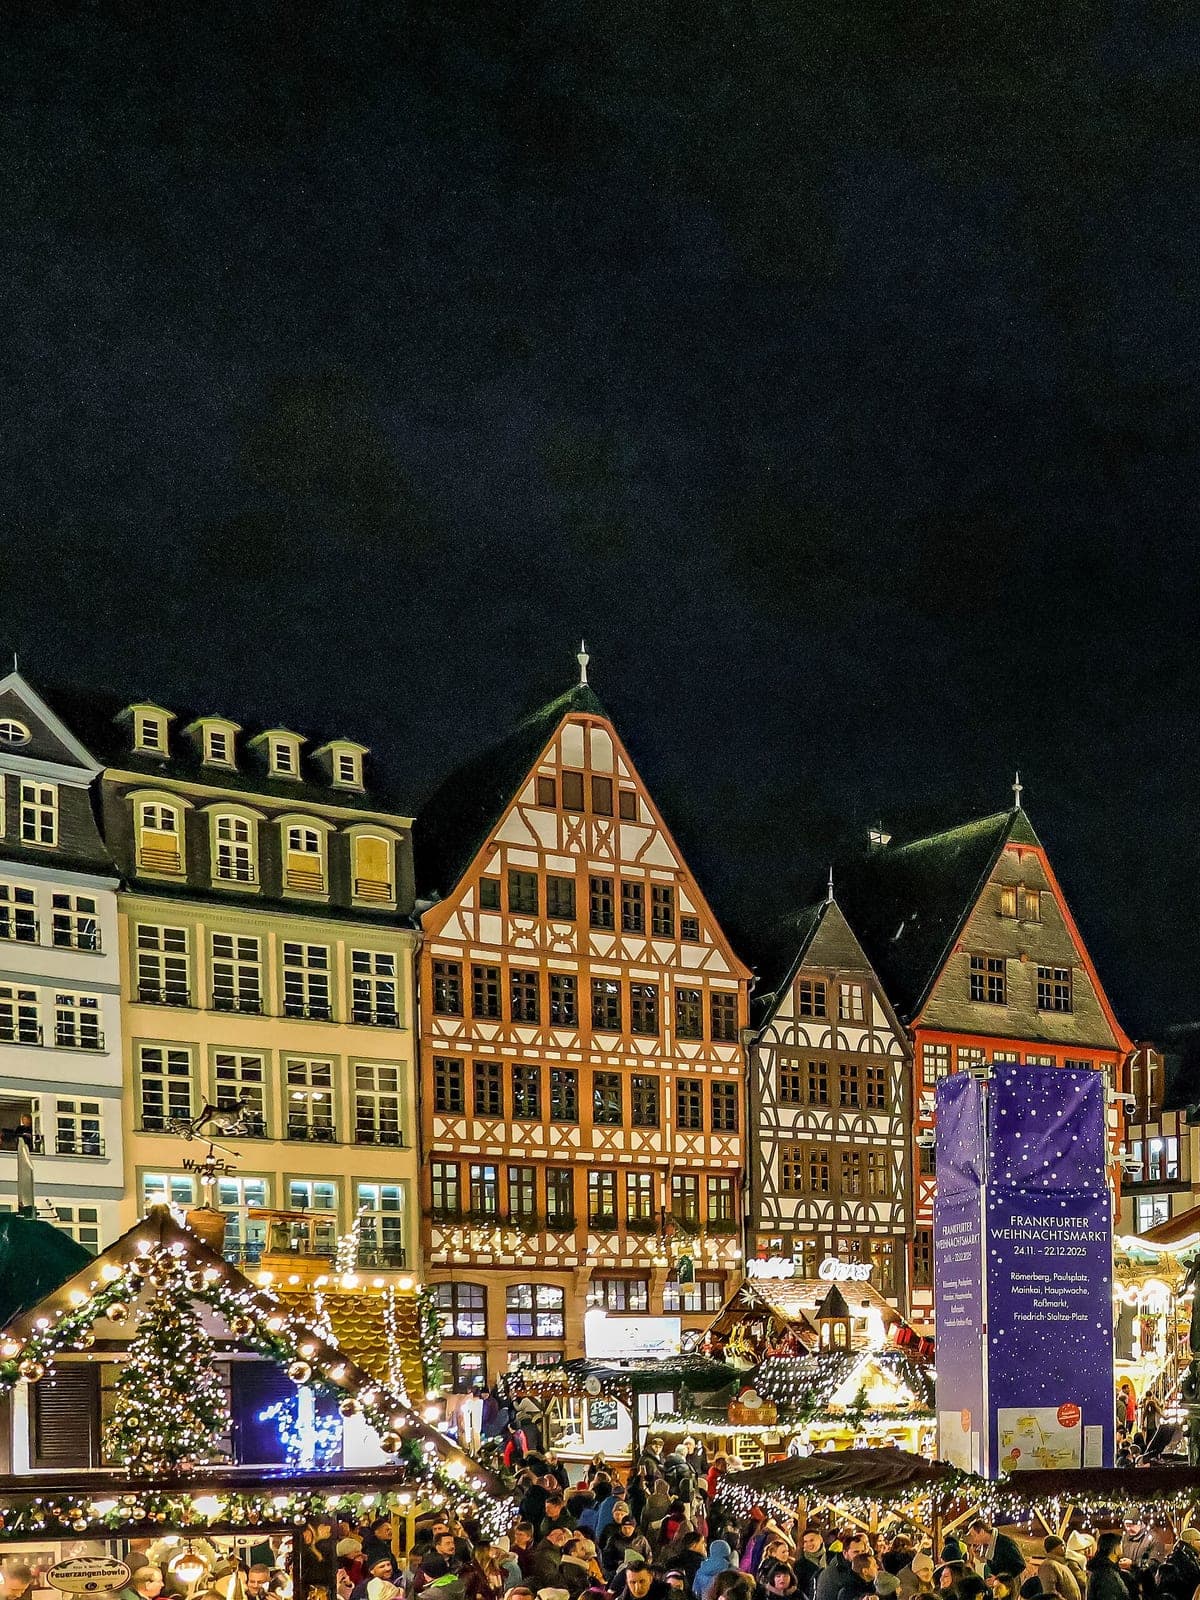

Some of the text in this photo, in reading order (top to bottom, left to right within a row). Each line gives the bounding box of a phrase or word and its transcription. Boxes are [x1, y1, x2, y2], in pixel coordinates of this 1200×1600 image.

[182, 1158, 195, 1170] W
[1010, 1215, 1089, 1228] FRANKFURTER
[942, 1222, 972, 1236] FRANKFURTER
[990, 1228, 1107, 1241] WEIHNACHTSMARKT
[935, 1233, 980, 1250] WEIHNACHTSMARKT
[1014, 1245, 1036, 1255] 24.11.
[1044, 1246, 1087, 1256] 22.12.2025
[1010, 1271, 1090, 1283] Römerberg, Paulsplatz,
[1011, 1285, 1090, 1296] Mainkai, Hauptwache,
[1033, 1298, 1069, 1309] Roßmarkt,
[1013, 1312, 1089, 1321] Friedrich-Stoltze-Platz
[50, 1568, 126, 1578] Feuerzangenbowle
